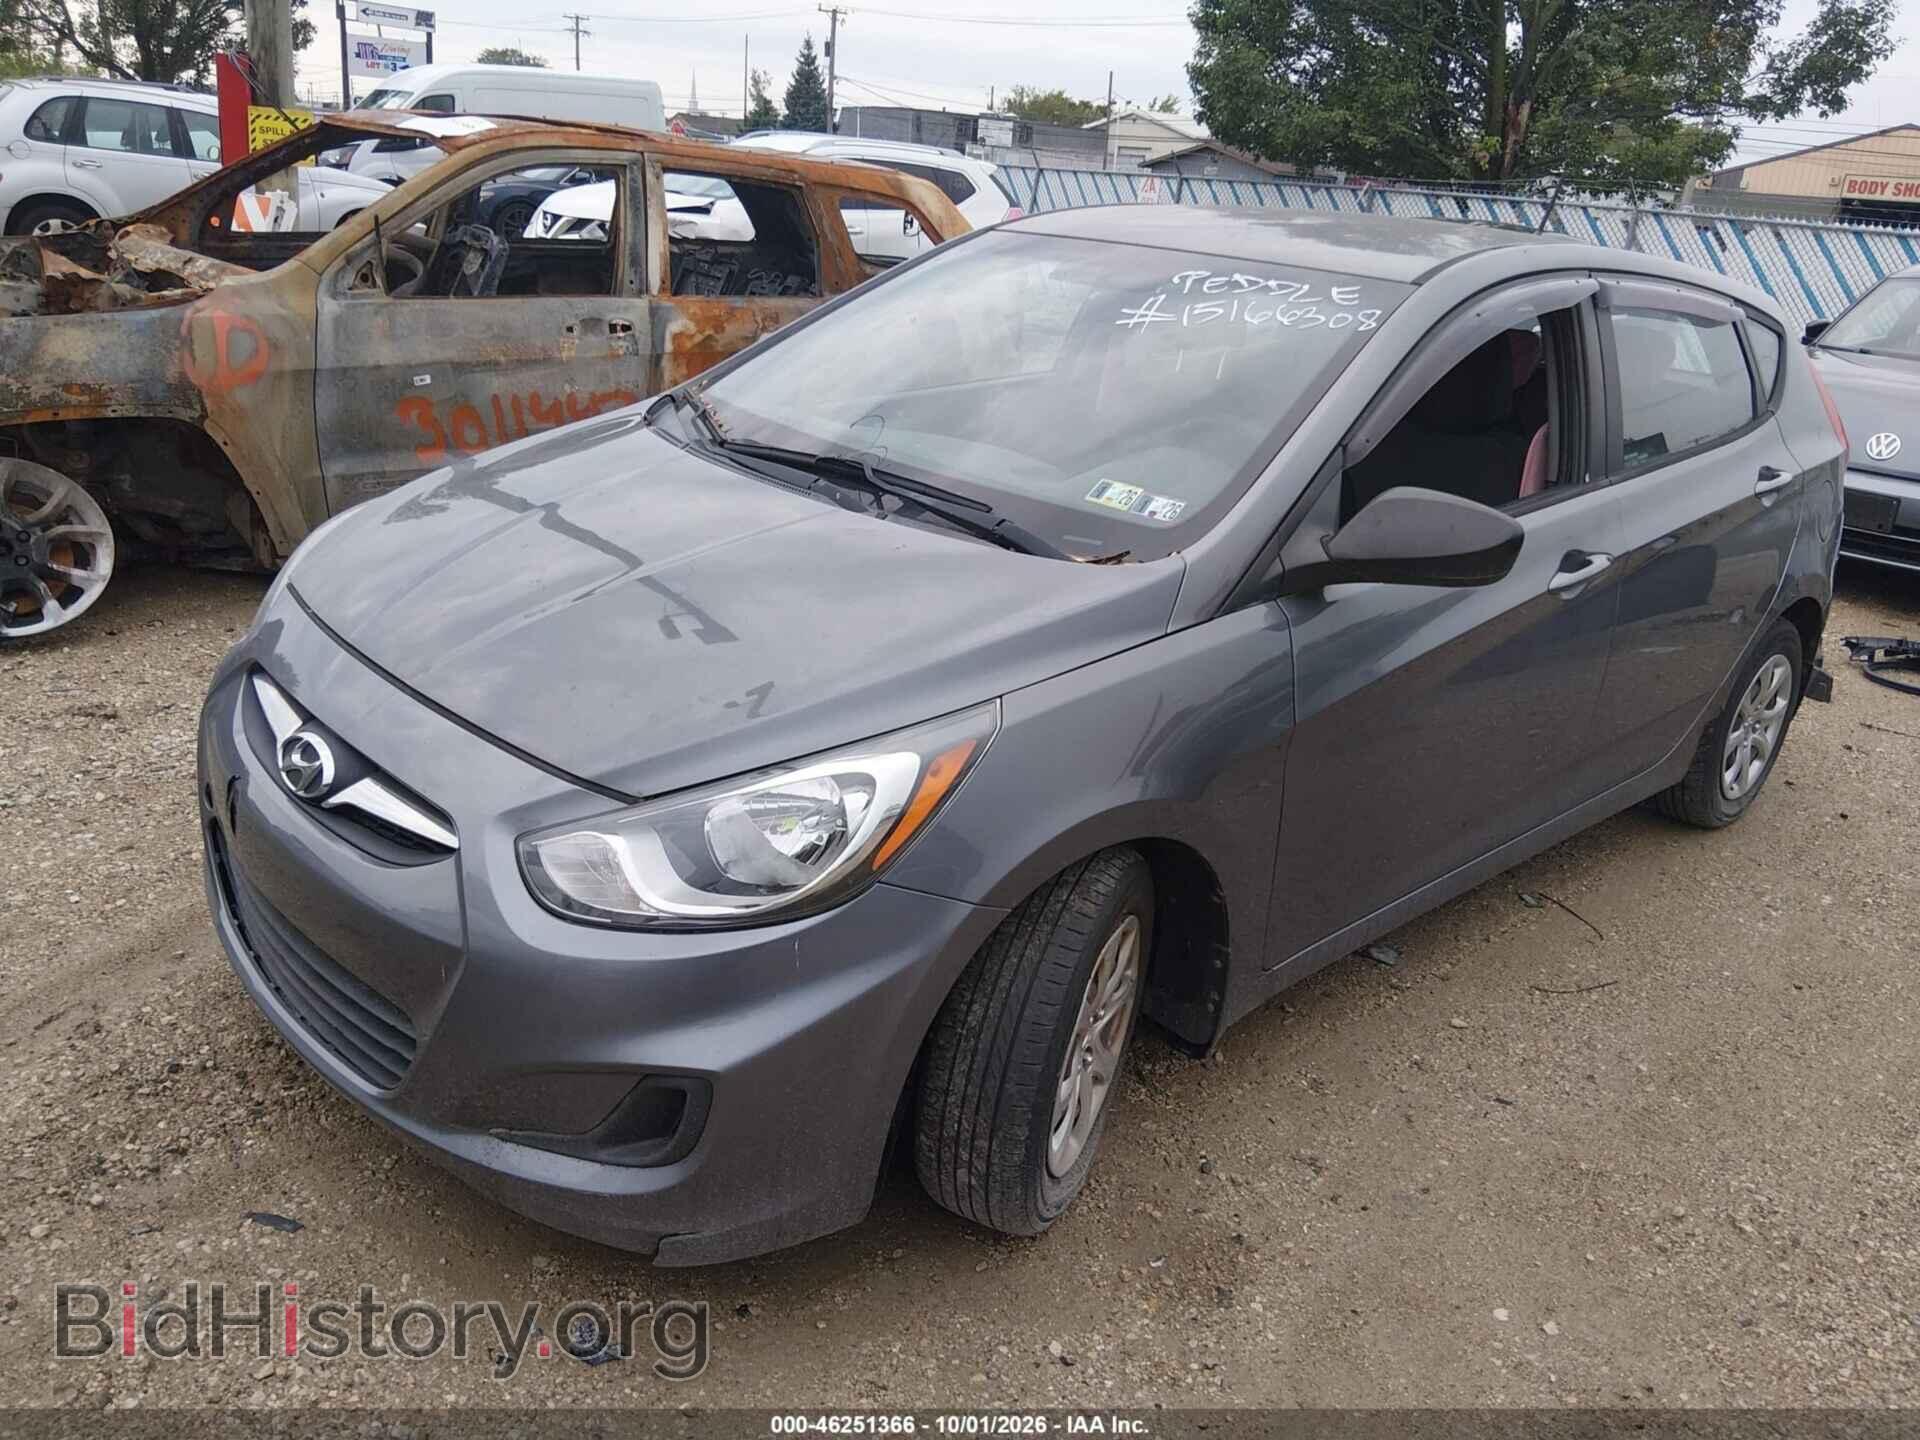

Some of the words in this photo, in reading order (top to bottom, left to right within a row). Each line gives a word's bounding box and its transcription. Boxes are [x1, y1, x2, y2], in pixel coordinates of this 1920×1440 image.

[258, 126, 287, 137] SPILL
[1847, 179, 1889, 196] BODY
[1172, 270, 1361, 305] PEDDLE
